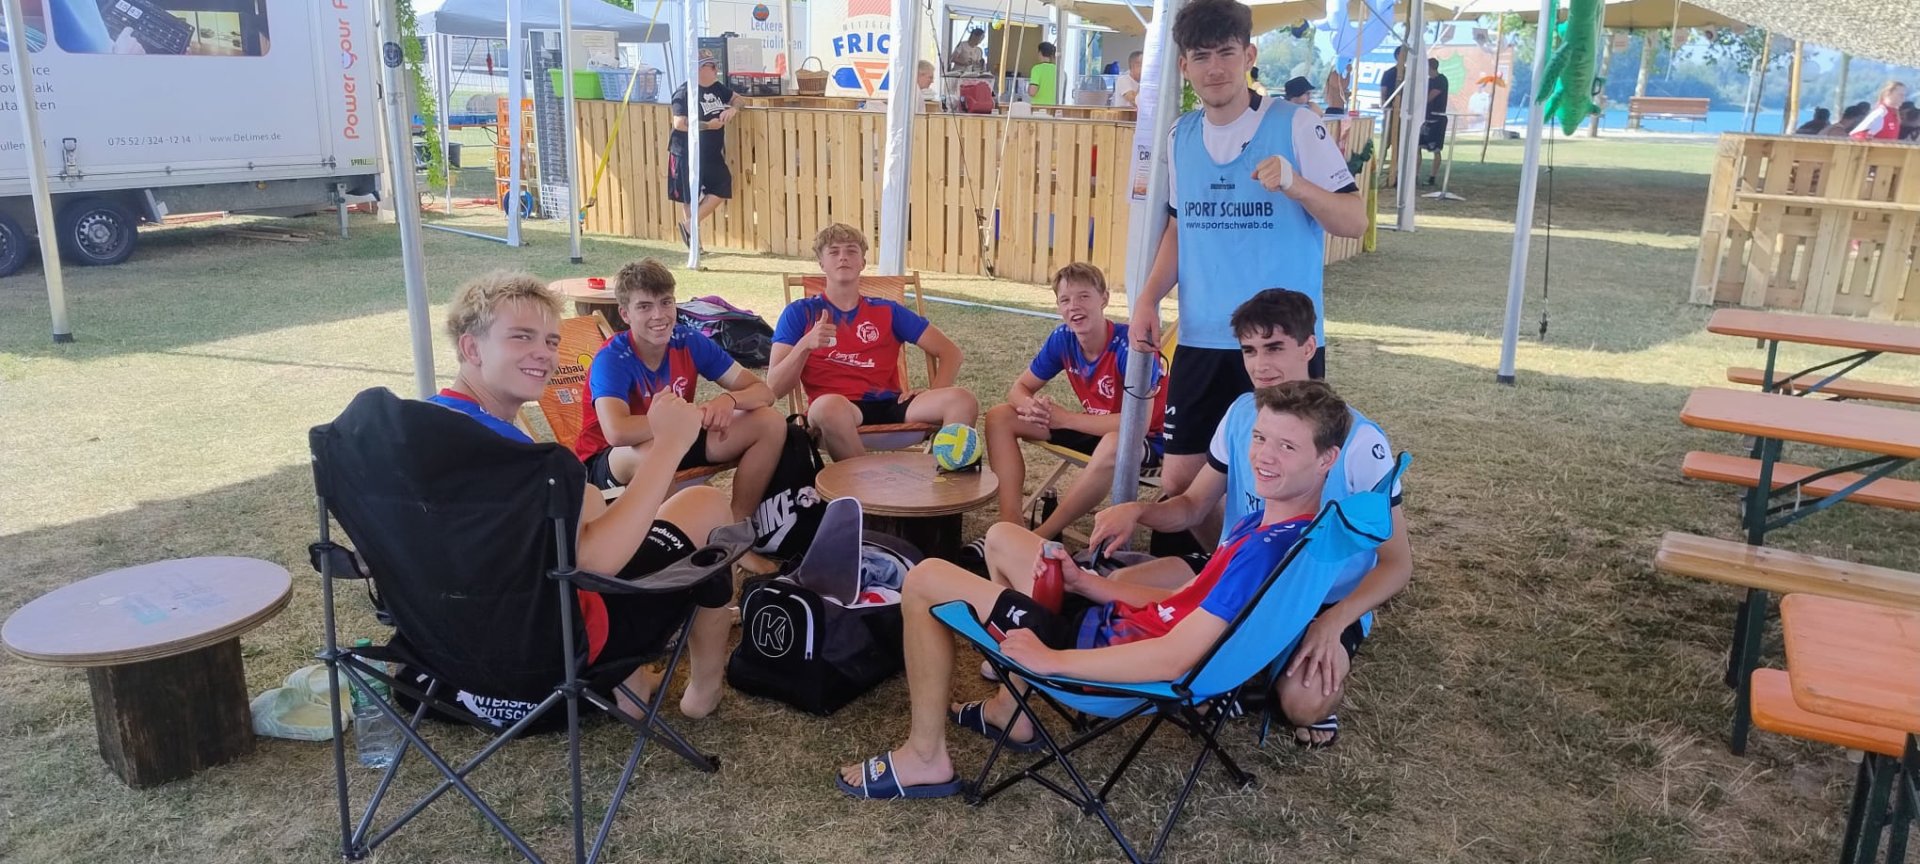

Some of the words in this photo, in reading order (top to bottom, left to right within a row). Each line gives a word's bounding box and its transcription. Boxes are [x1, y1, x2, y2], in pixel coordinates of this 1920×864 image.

[832, 32, 891, 57] FRIC
[1184, 201, 1217, 217] SPORT
[1220, 201, 1274, 217] SCHWAB
[1186, 221, 1274, 230] www.sportschwab.de
